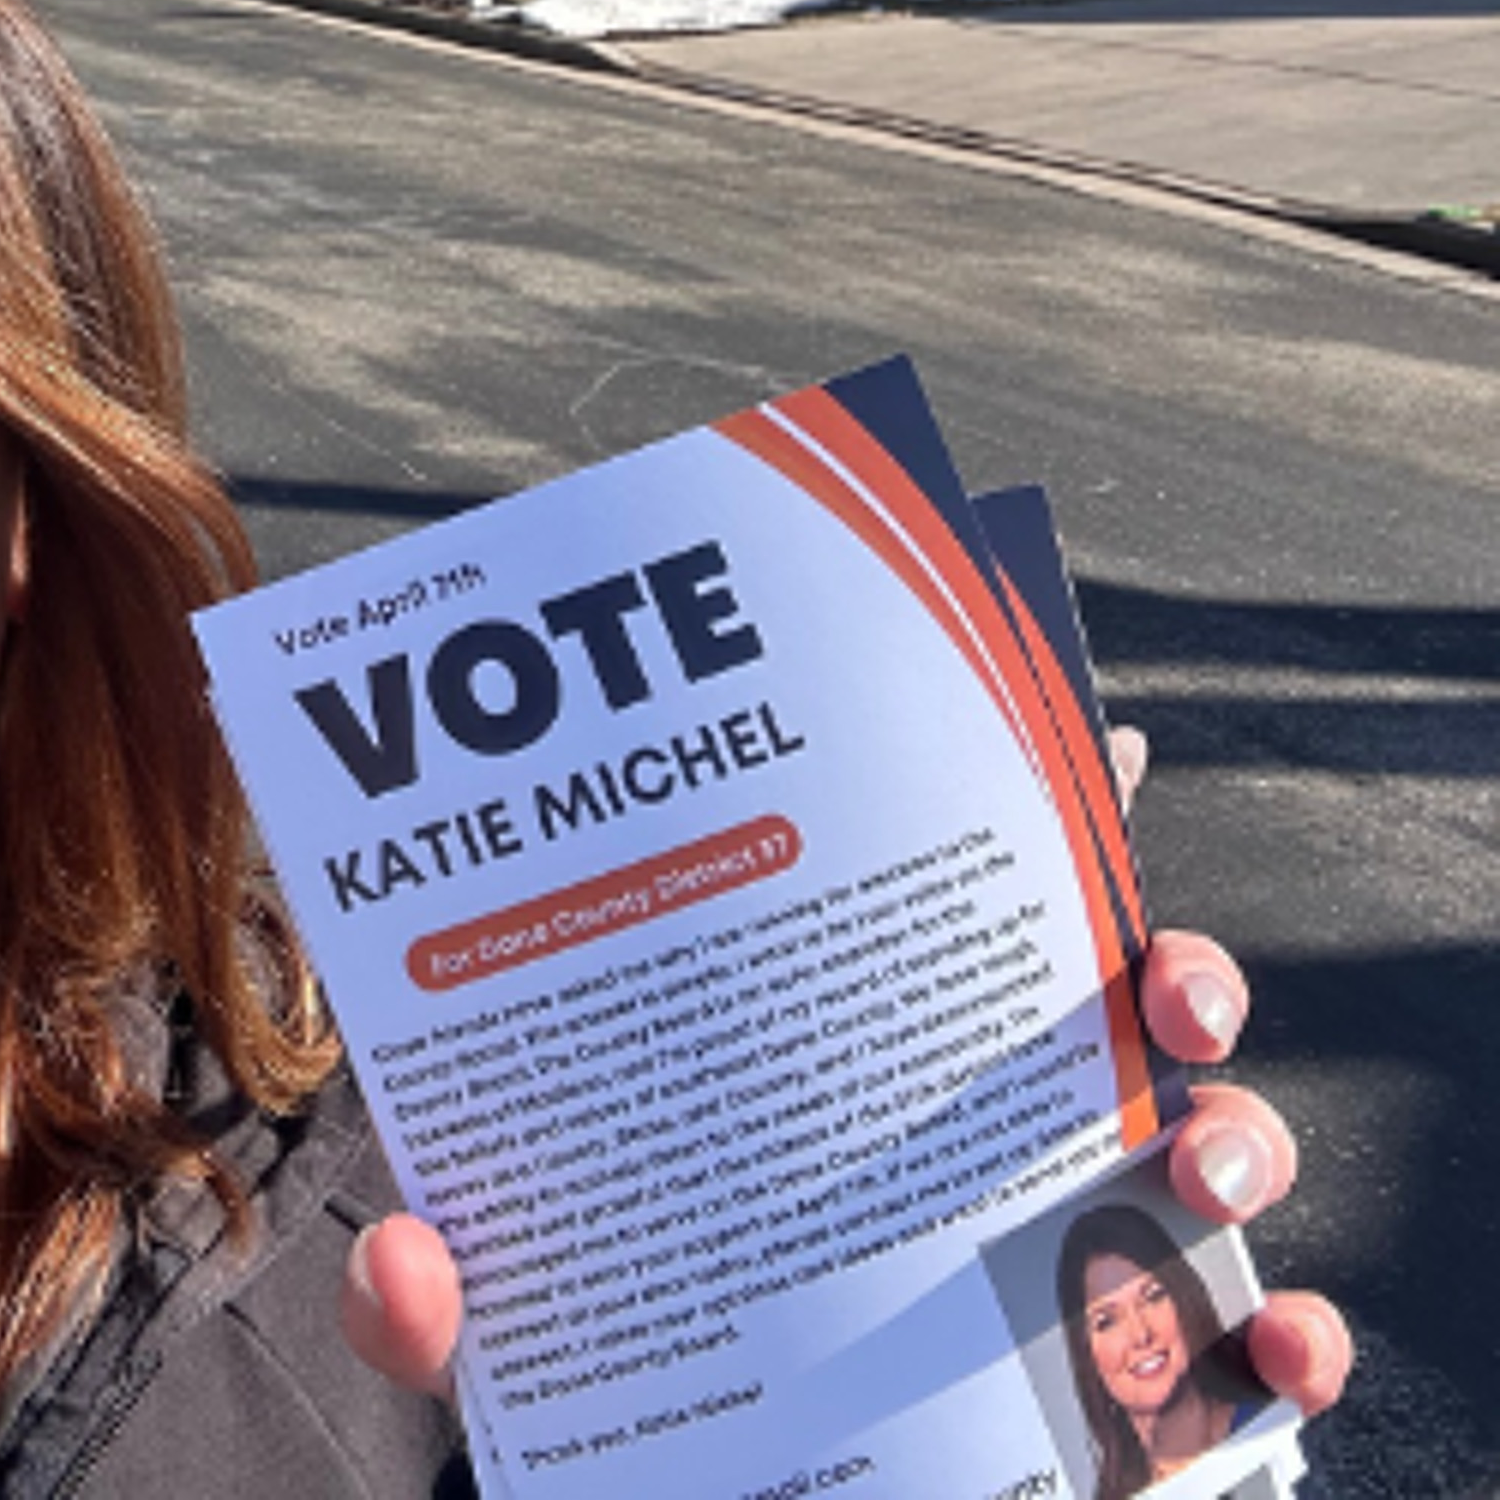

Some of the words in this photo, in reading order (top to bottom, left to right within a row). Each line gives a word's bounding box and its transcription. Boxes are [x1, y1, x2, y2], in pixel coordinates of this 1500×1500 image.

[275, 615, 349, 655] Vote
[358, 579, 428, 631] April
[431, 561, 487, 598] 7th
[292, 539, 764, 799] VOTE
[323, 800, 525, 913] KATIE
[532, 701, 806, 842] MICHEL
[430, 949, 473, 977] For
[552, 888, 651, 941] County
[653, 846, 760, 901] District
